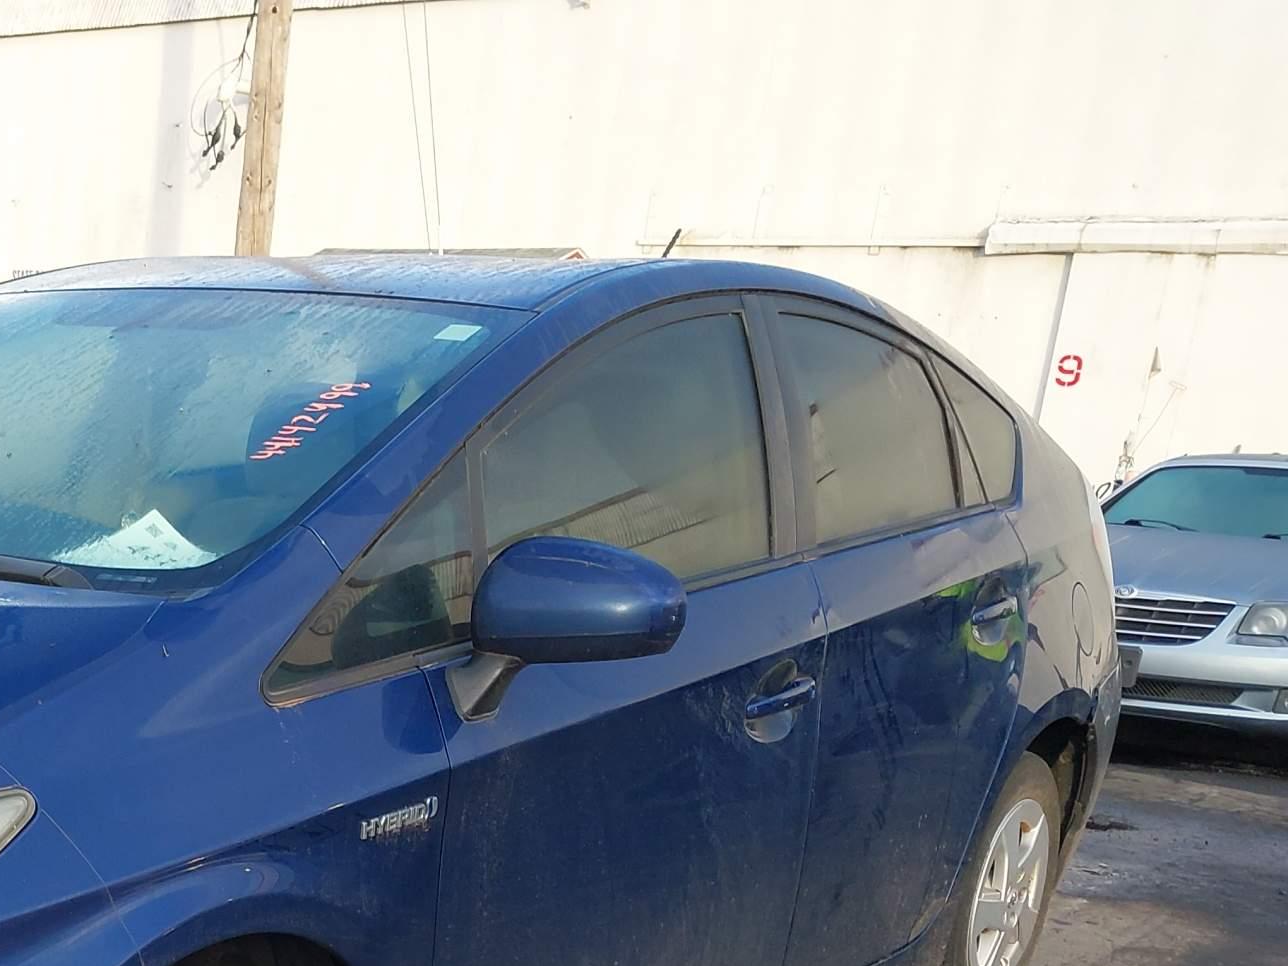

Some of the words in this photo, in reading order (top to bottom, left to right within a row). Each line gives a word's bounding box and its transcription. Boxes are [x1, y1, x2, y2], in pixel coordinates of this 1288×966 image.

[1055, 354, 1083, 387] 9
[249, 382, 372, 461] 44142499
[360, 796, 439, 841] HYBRID
